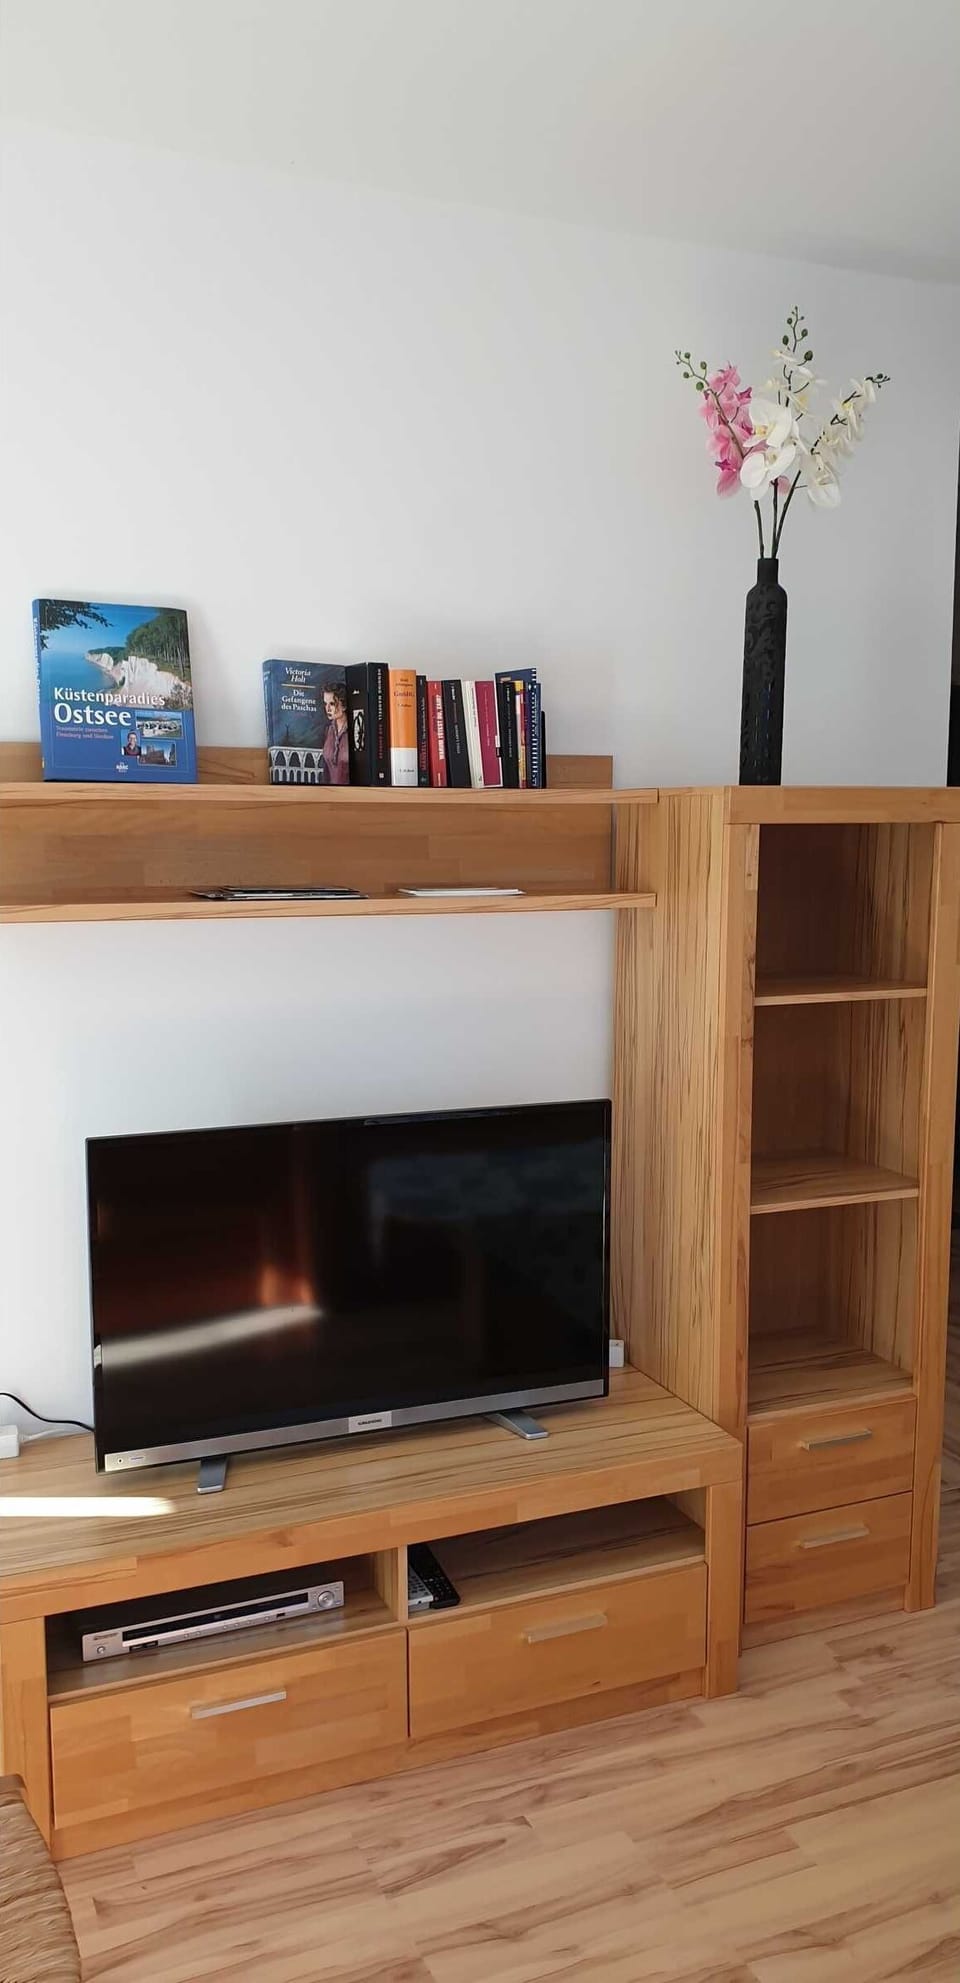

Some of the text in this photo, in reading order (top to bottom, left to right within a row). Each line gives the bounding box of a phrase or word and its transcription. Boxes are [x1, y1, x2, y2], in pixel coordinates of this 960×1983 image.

[285, 666, 311, 676] Victoria
[290, 674, 306, 683] Holt
[54, 687, 166, 706] Küstenparadies
[293, 689, 305, 697] Die
[281, 695, 316, 705] Gefangene
[292, 704, 317, 712] Paschas
[54, 702, 131, 726] Ostsee
